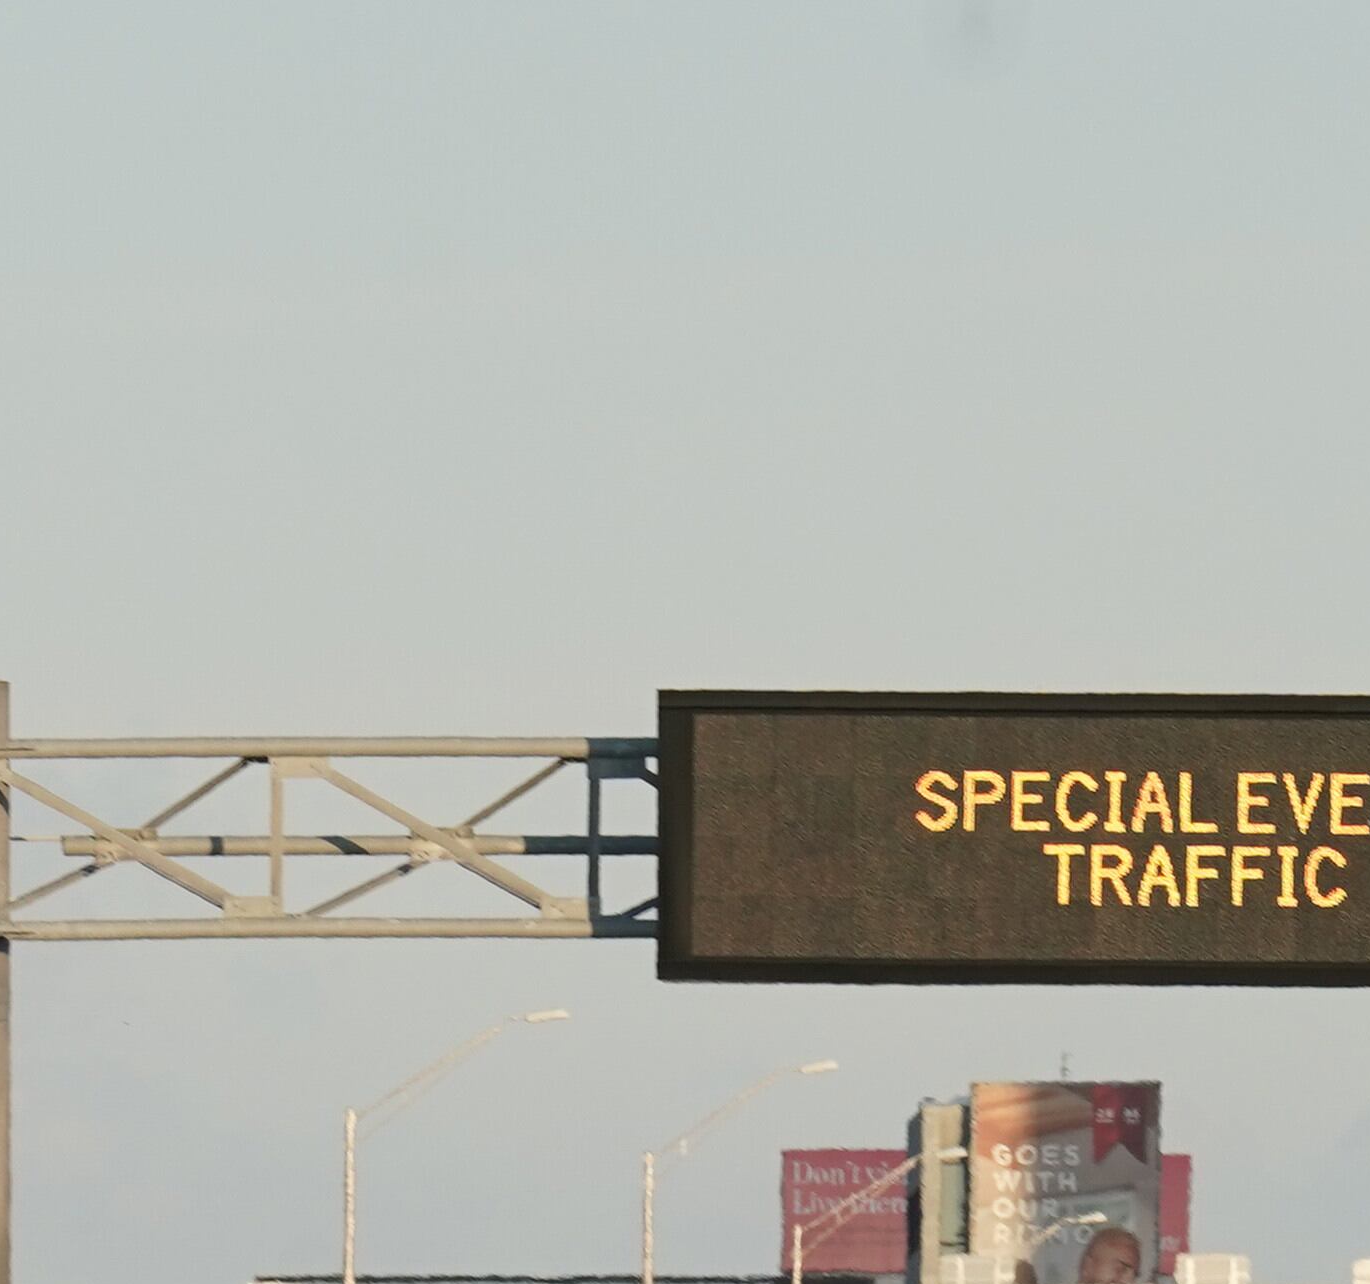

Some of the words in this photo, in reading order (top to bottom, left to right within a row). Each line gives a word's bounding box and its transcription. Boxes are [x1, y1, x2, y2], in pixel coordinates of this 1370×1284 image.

[914, 769, 1219, 834] SPECIAL
[1043, 844, 1349, 909] TRAFFIC
[991, 1142, 1080, 1167] GOES
[992, 1170, 1078, 1194] WITH
[992, 1197, 1060, 1219] OUR
